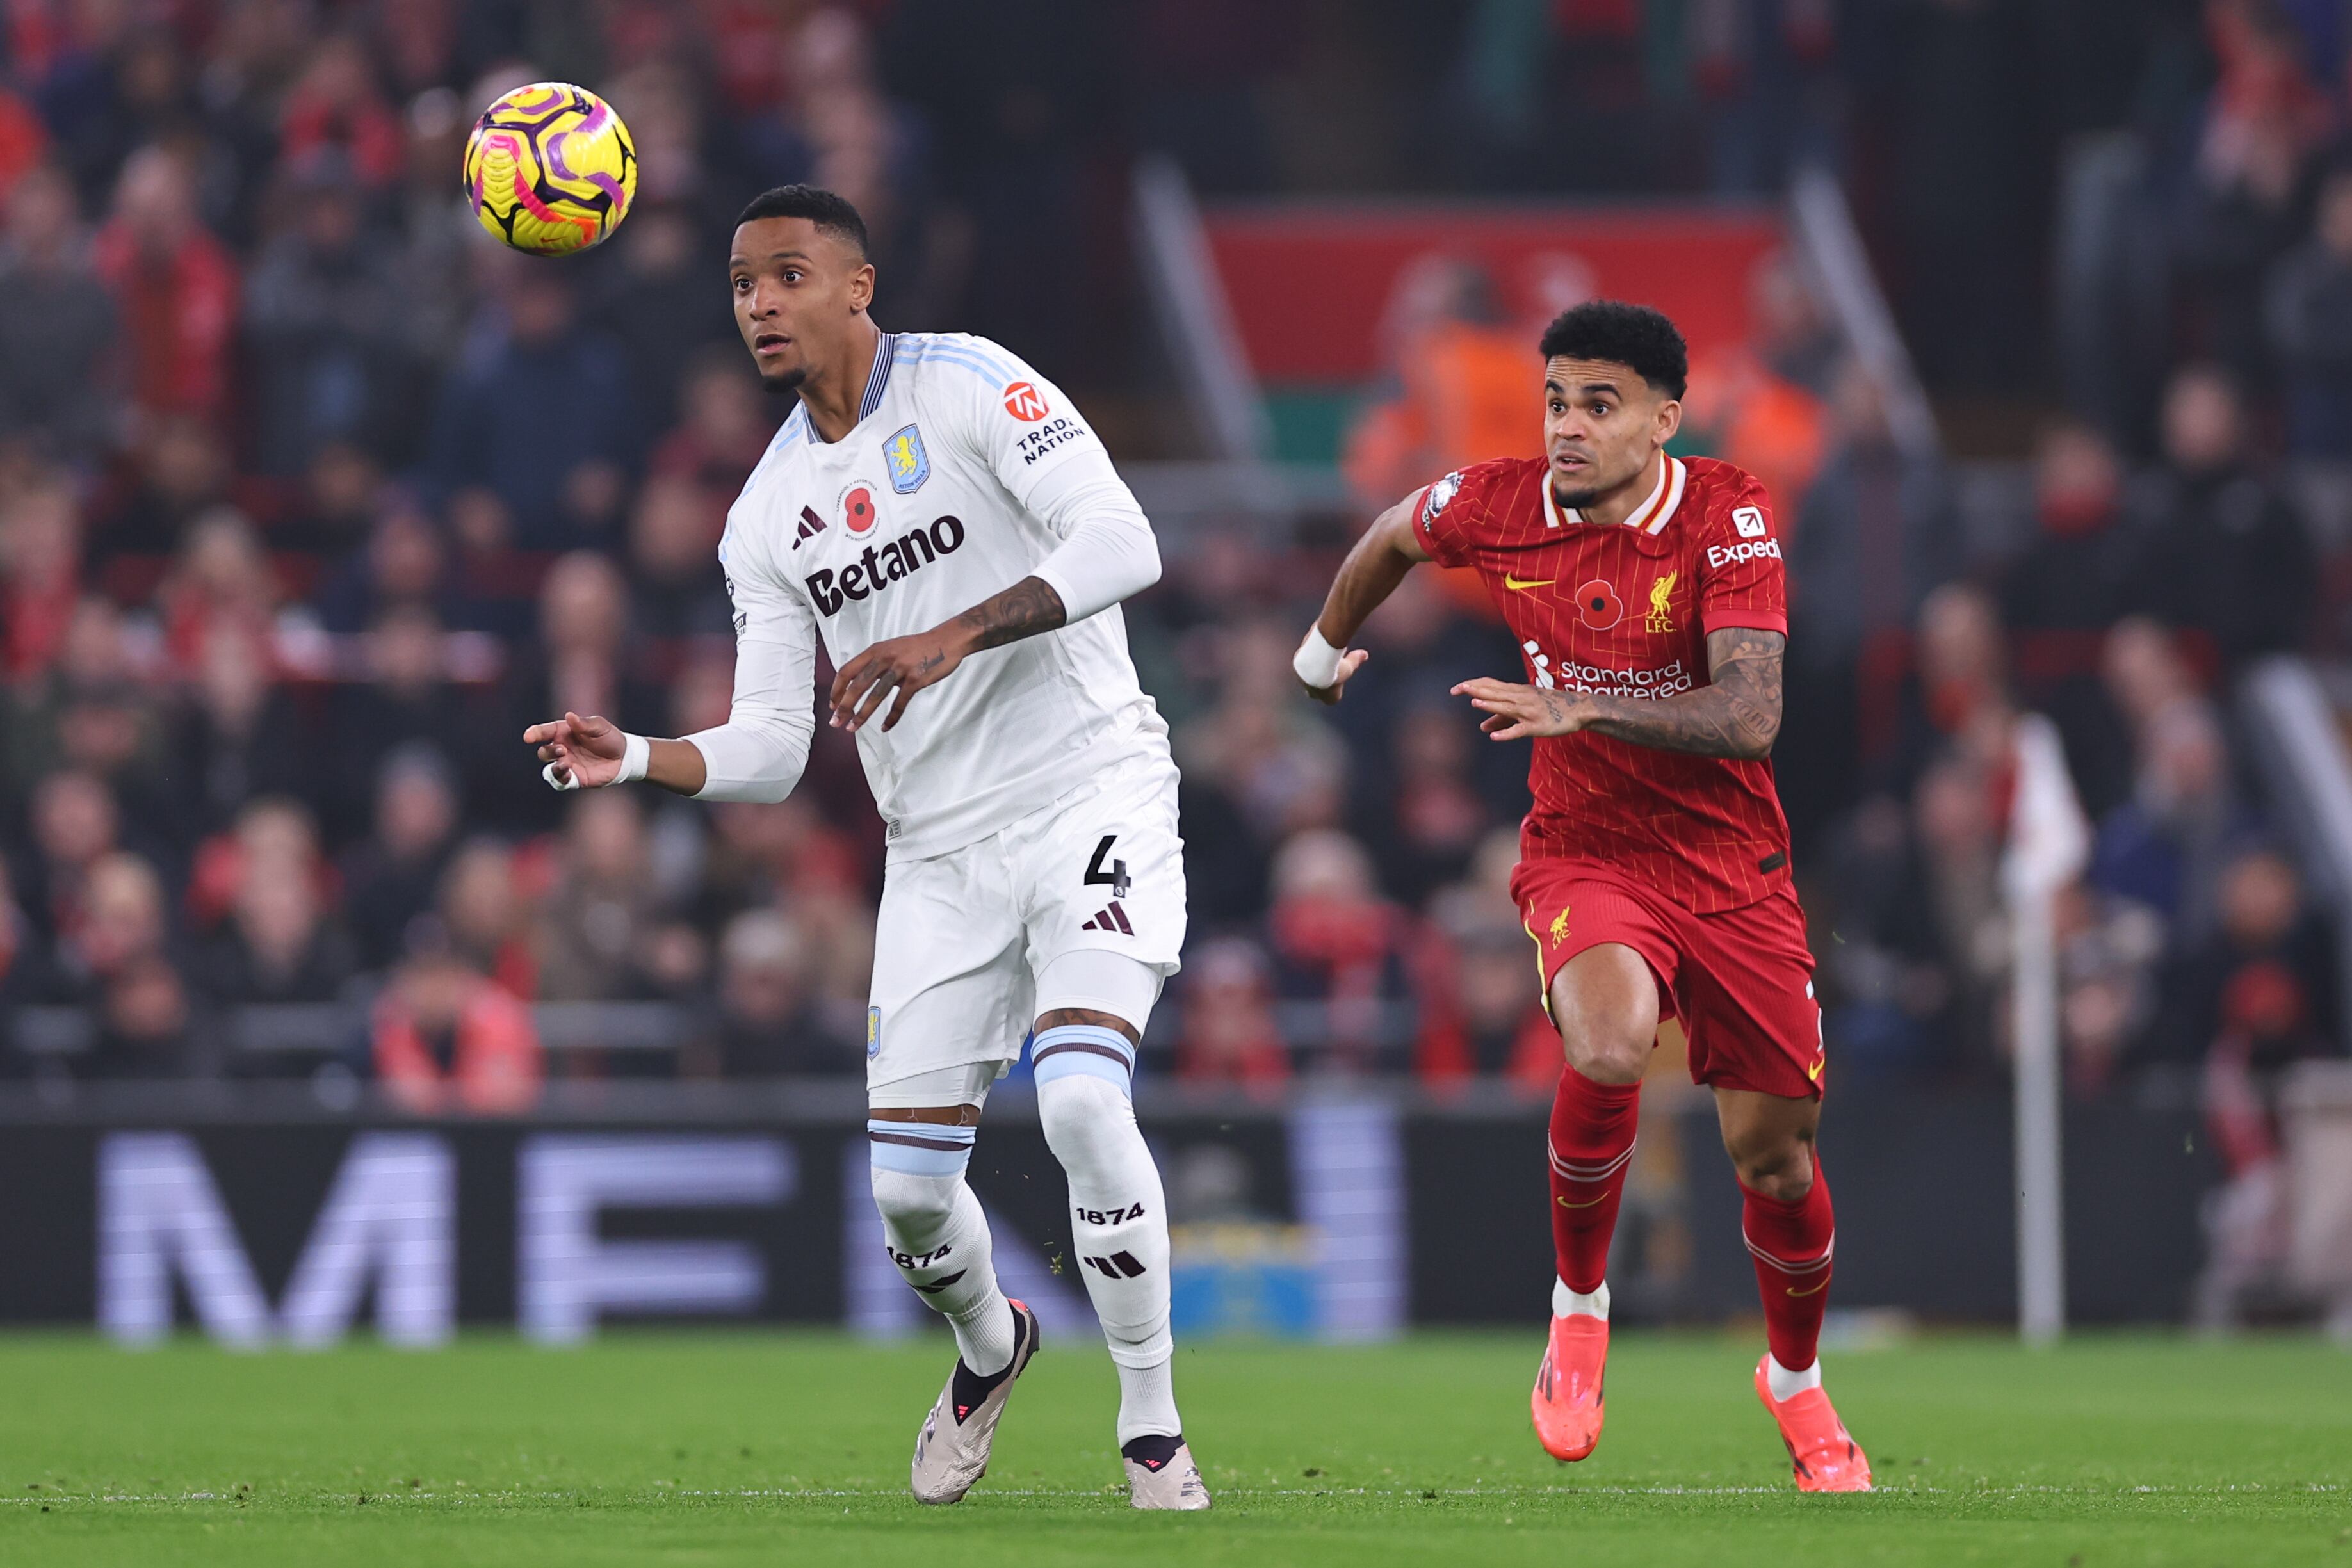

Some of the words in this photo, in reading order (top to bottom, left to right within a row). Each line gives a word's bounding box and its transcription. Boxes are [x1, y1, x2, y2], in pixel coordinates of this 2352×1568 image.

[1024, 428, 1085, 465] NATION
[805, 515, 964, 617] Betano
[1707, 537, 1783, 569] Expedi
[1561, 659, 1682, 685] standard
[1084, 835, 1131, 898] 4
[1077, 1202, 1145, 1225] 1874
